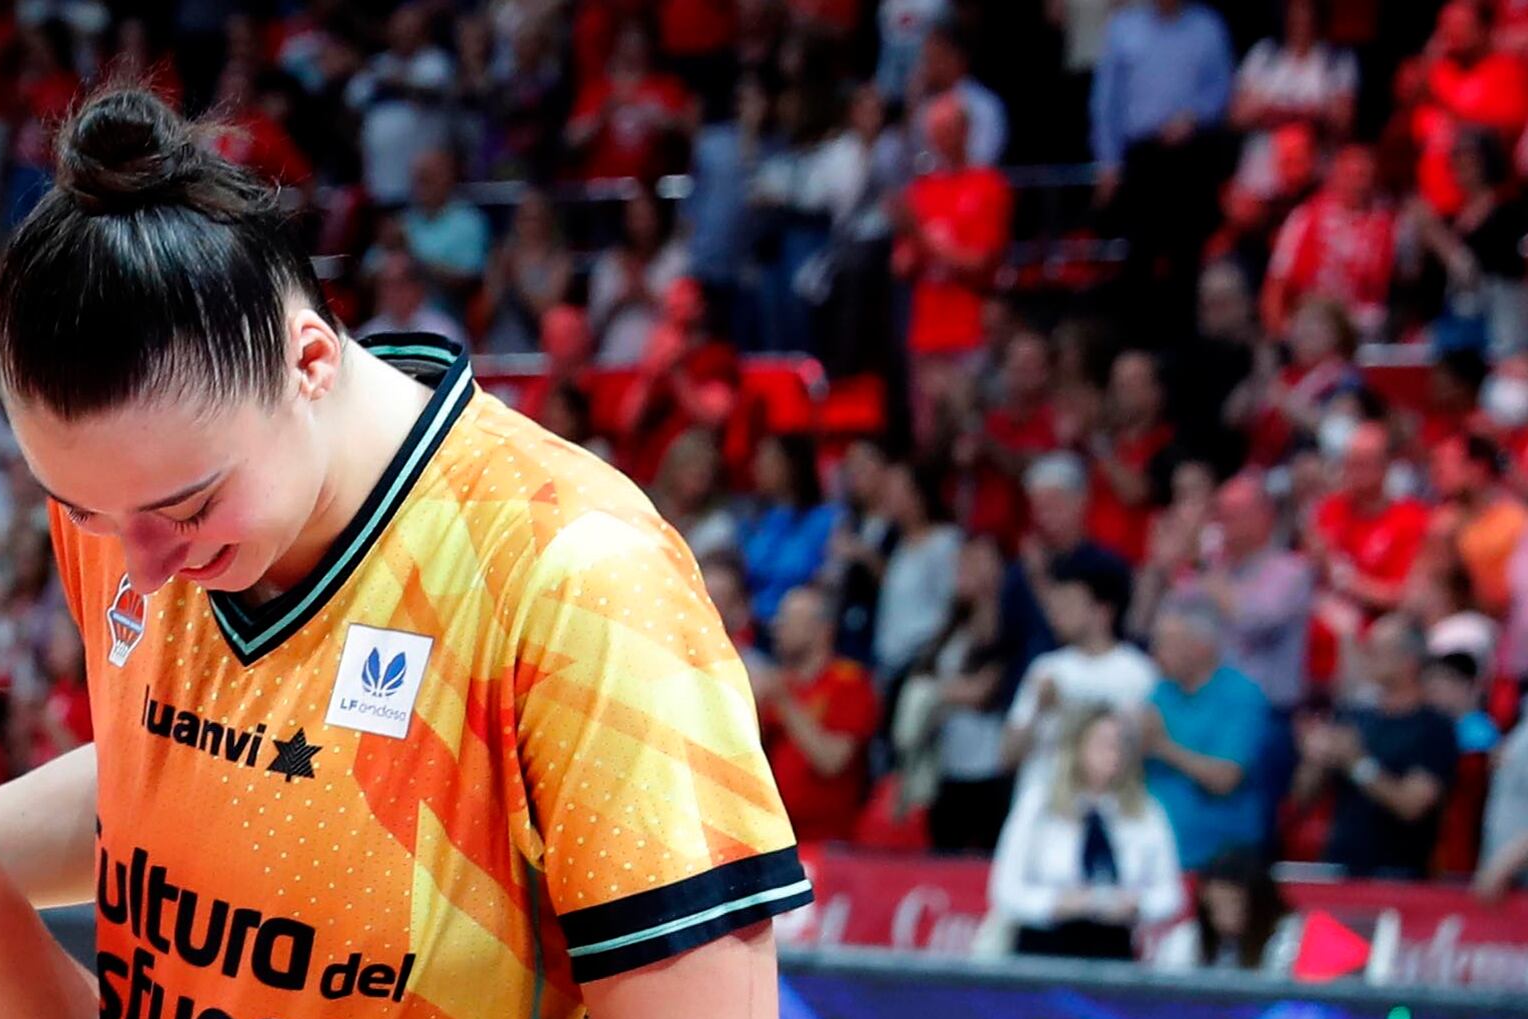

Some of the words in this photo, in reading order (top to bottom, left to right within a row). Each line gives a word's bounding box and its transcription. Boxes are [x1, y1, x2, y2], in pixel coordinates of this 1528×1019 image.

[339, 698, 358, 711] LF
[97, 815, 315, 990] ultura
[320, 953, 416, 1002] del
